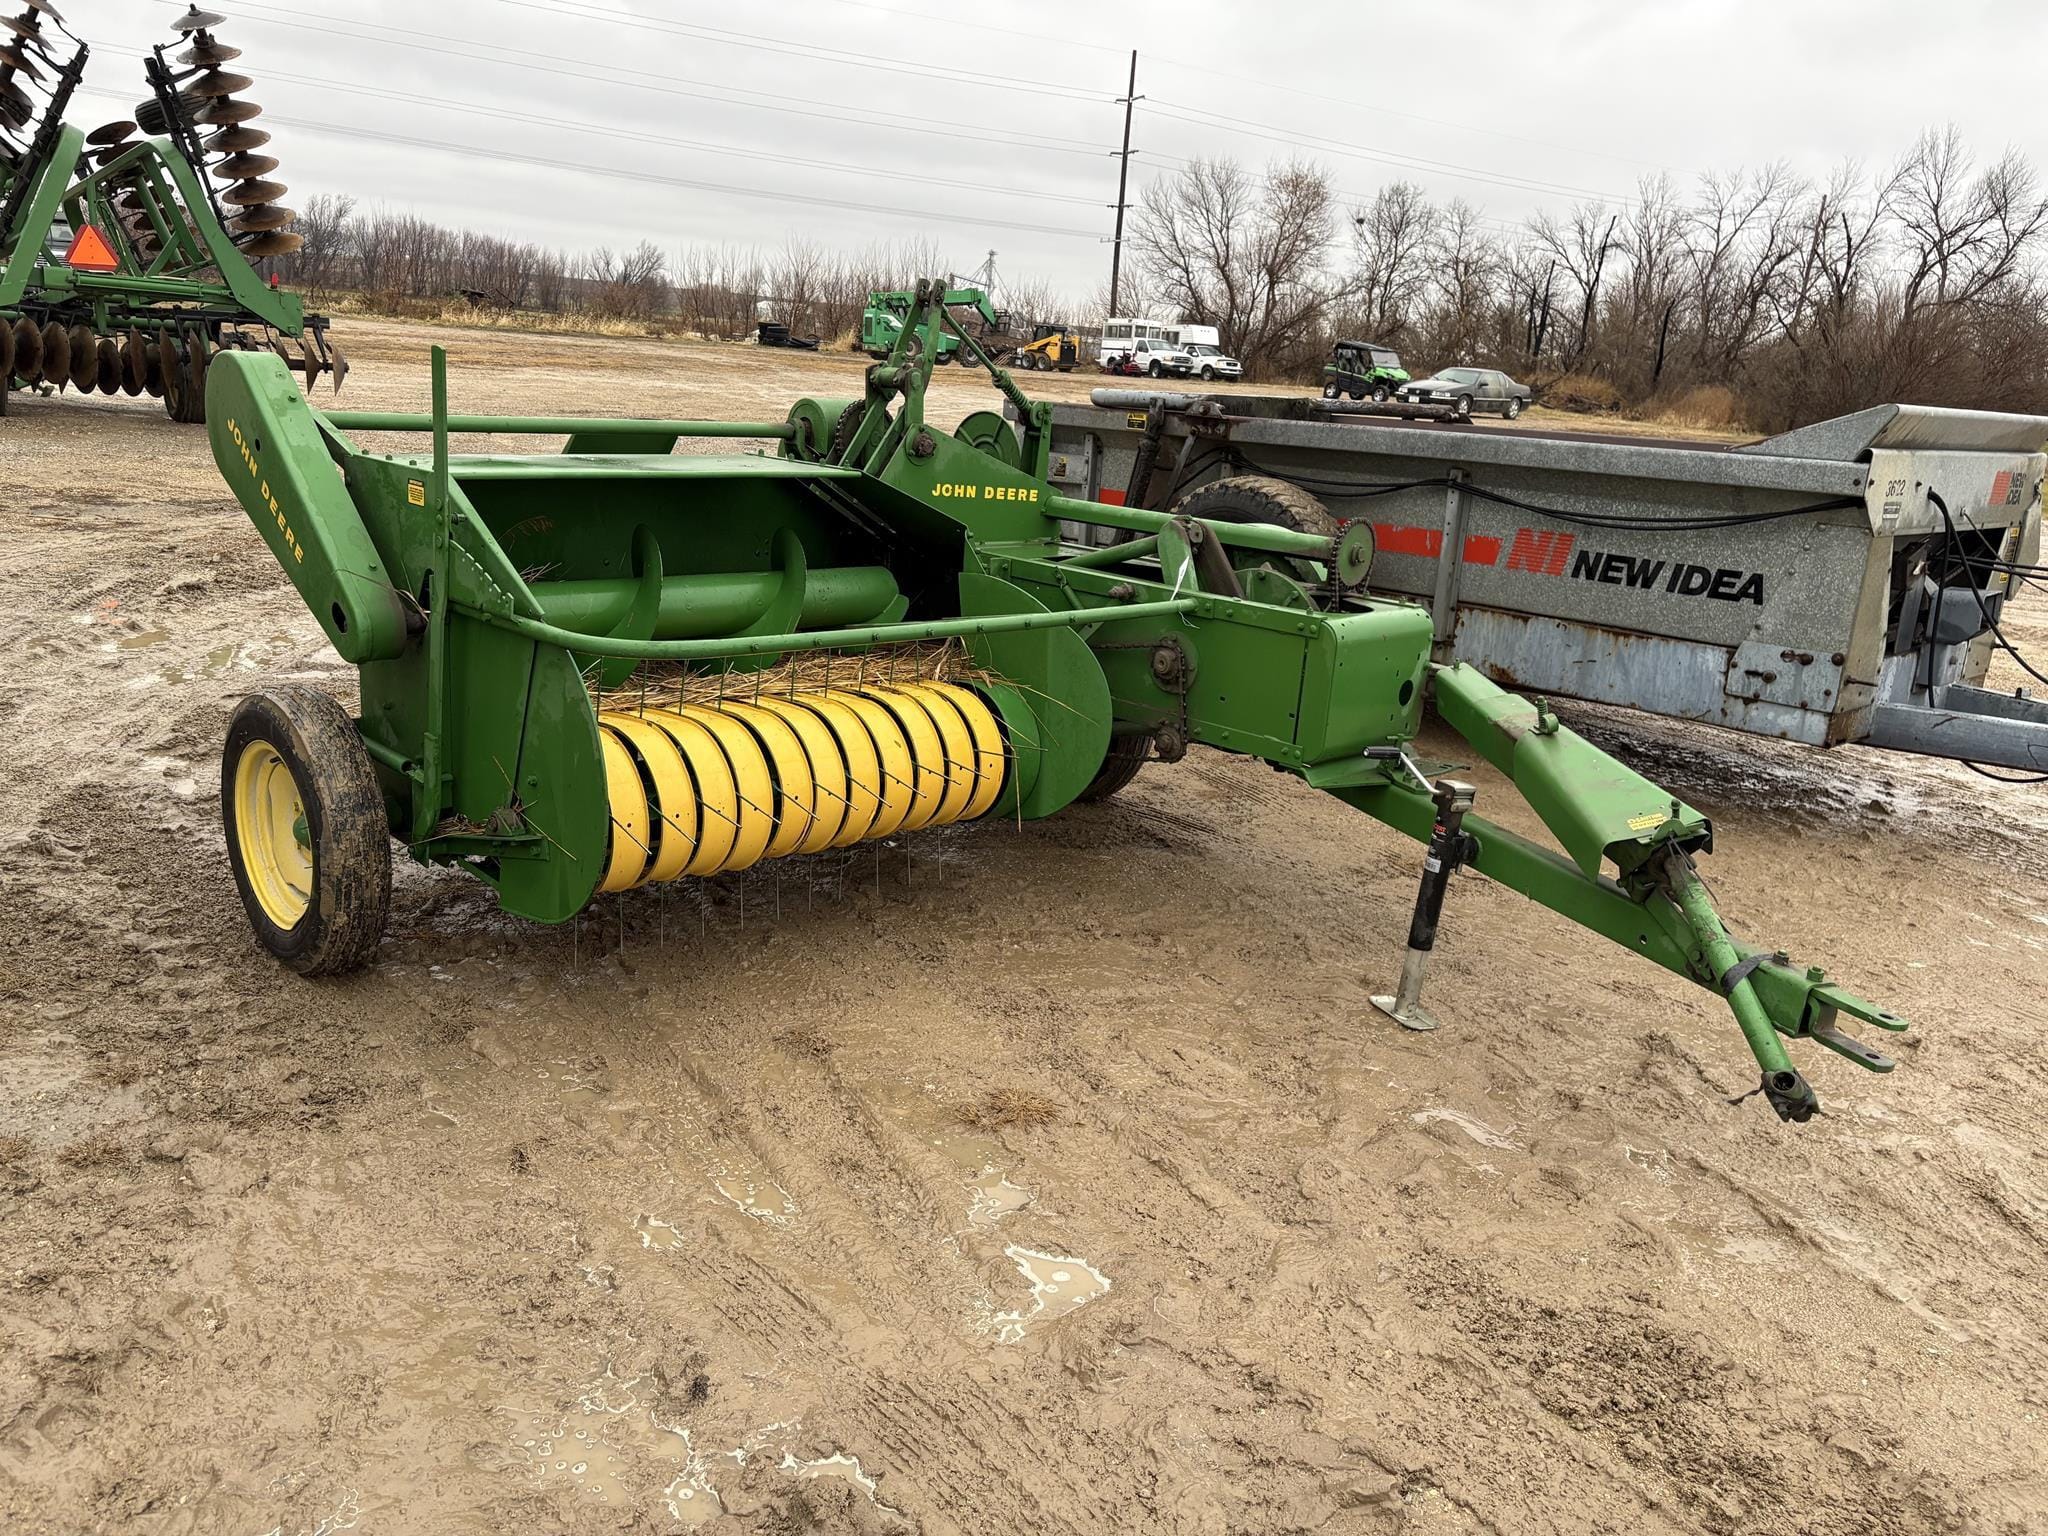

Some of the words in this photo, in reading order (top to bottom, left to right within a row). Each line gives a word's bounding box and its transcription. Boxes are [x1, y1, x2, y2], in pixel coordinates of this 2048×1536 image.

[227, 418, 258, 478] JOHN
[261, 479, 304, 564] DEERE
[931, 483, 977, 498] JOHN
[984, 486, 1039, 502] DEERE
[1506, 527, 1576, 577] NI
[1570, 549, 1666, 590] NEW
[1665, 563, 1765, 606] IDEA
